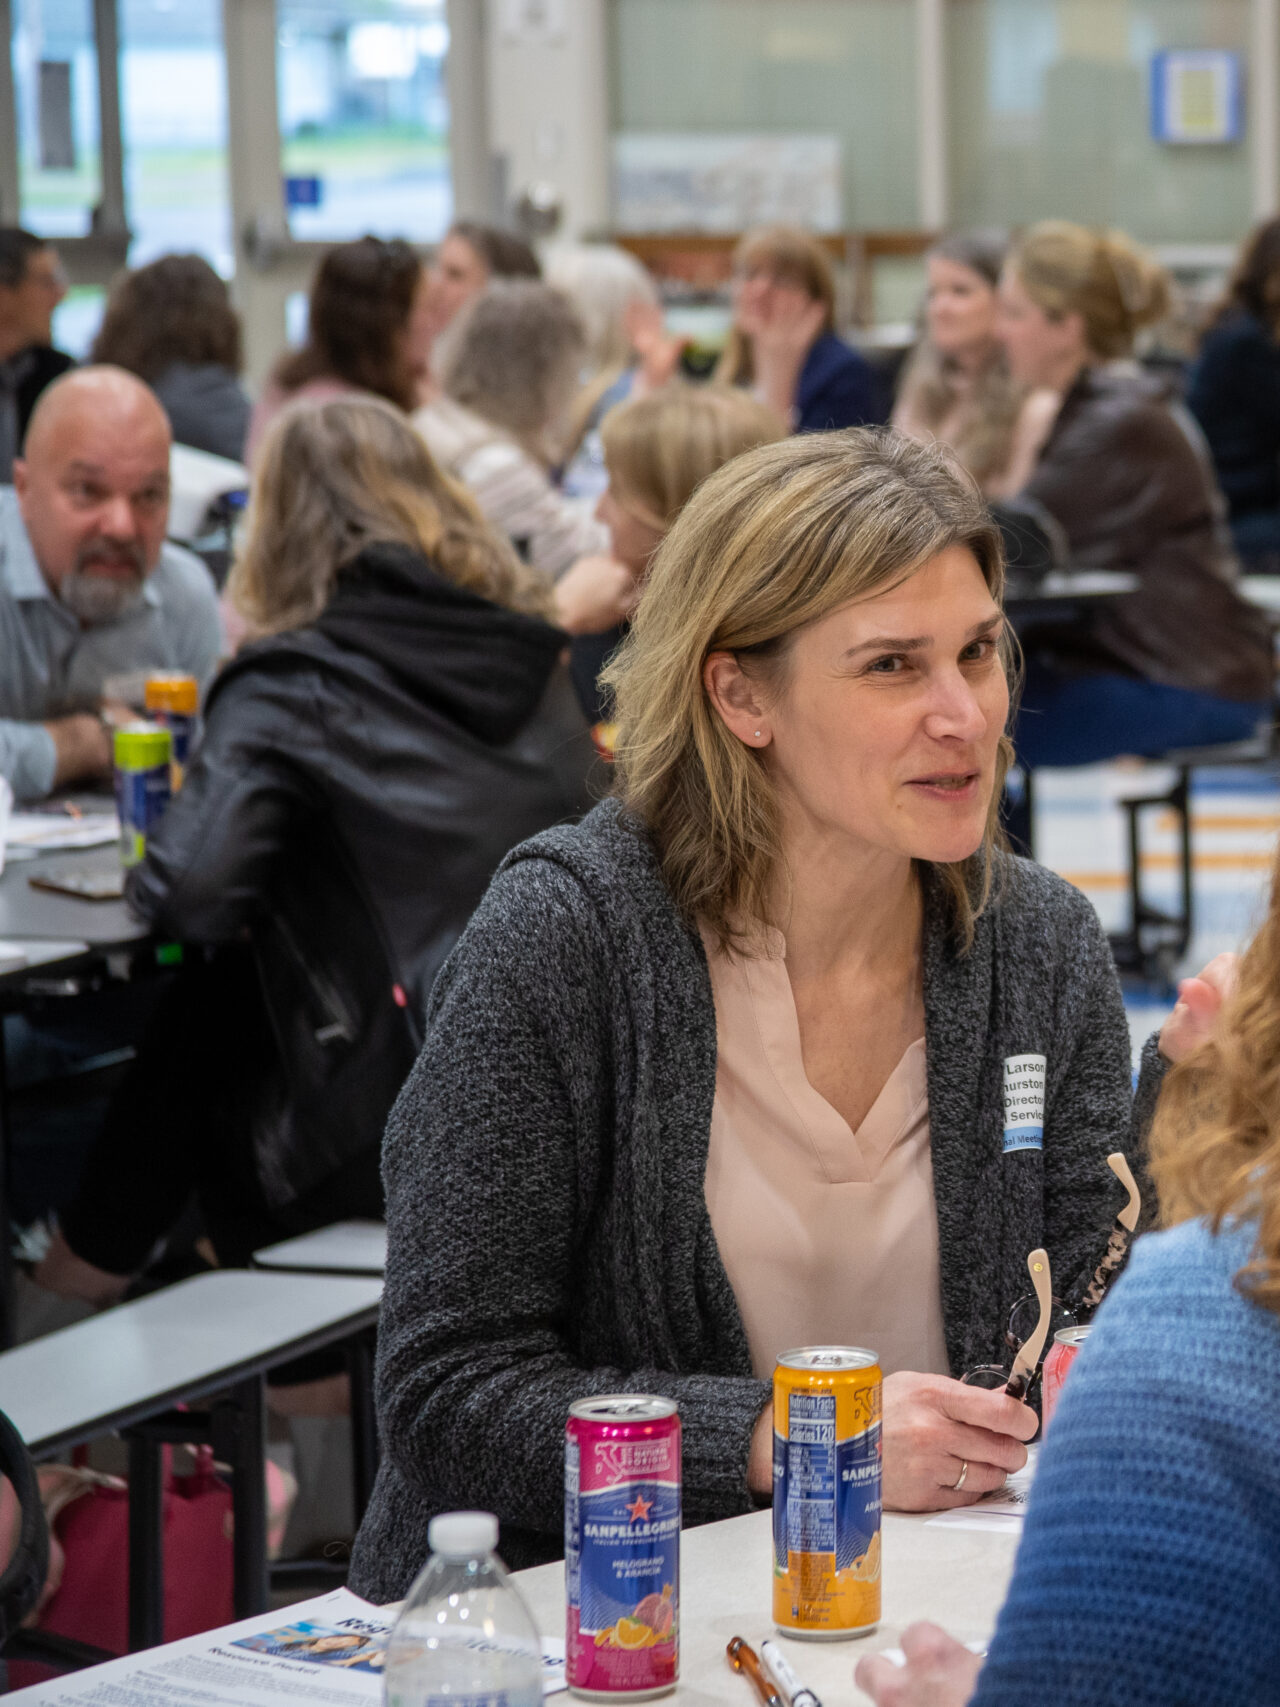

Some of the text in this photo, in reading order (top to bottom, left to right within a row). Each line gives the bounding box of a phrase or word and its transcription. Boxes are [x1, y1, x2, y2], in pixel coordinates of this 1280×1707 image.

[1007, 1063, 1045, 1075] Larson
[1010, 1109, 1044, 1121] Servic
[790, 1394, 834, 1410] Nutrition Facts
[816, 1425, 834, 1442] 120
[612, 1556, 665, 1569] MELOGRANO
[624, 1567, 662, 1578] ARANCIA
